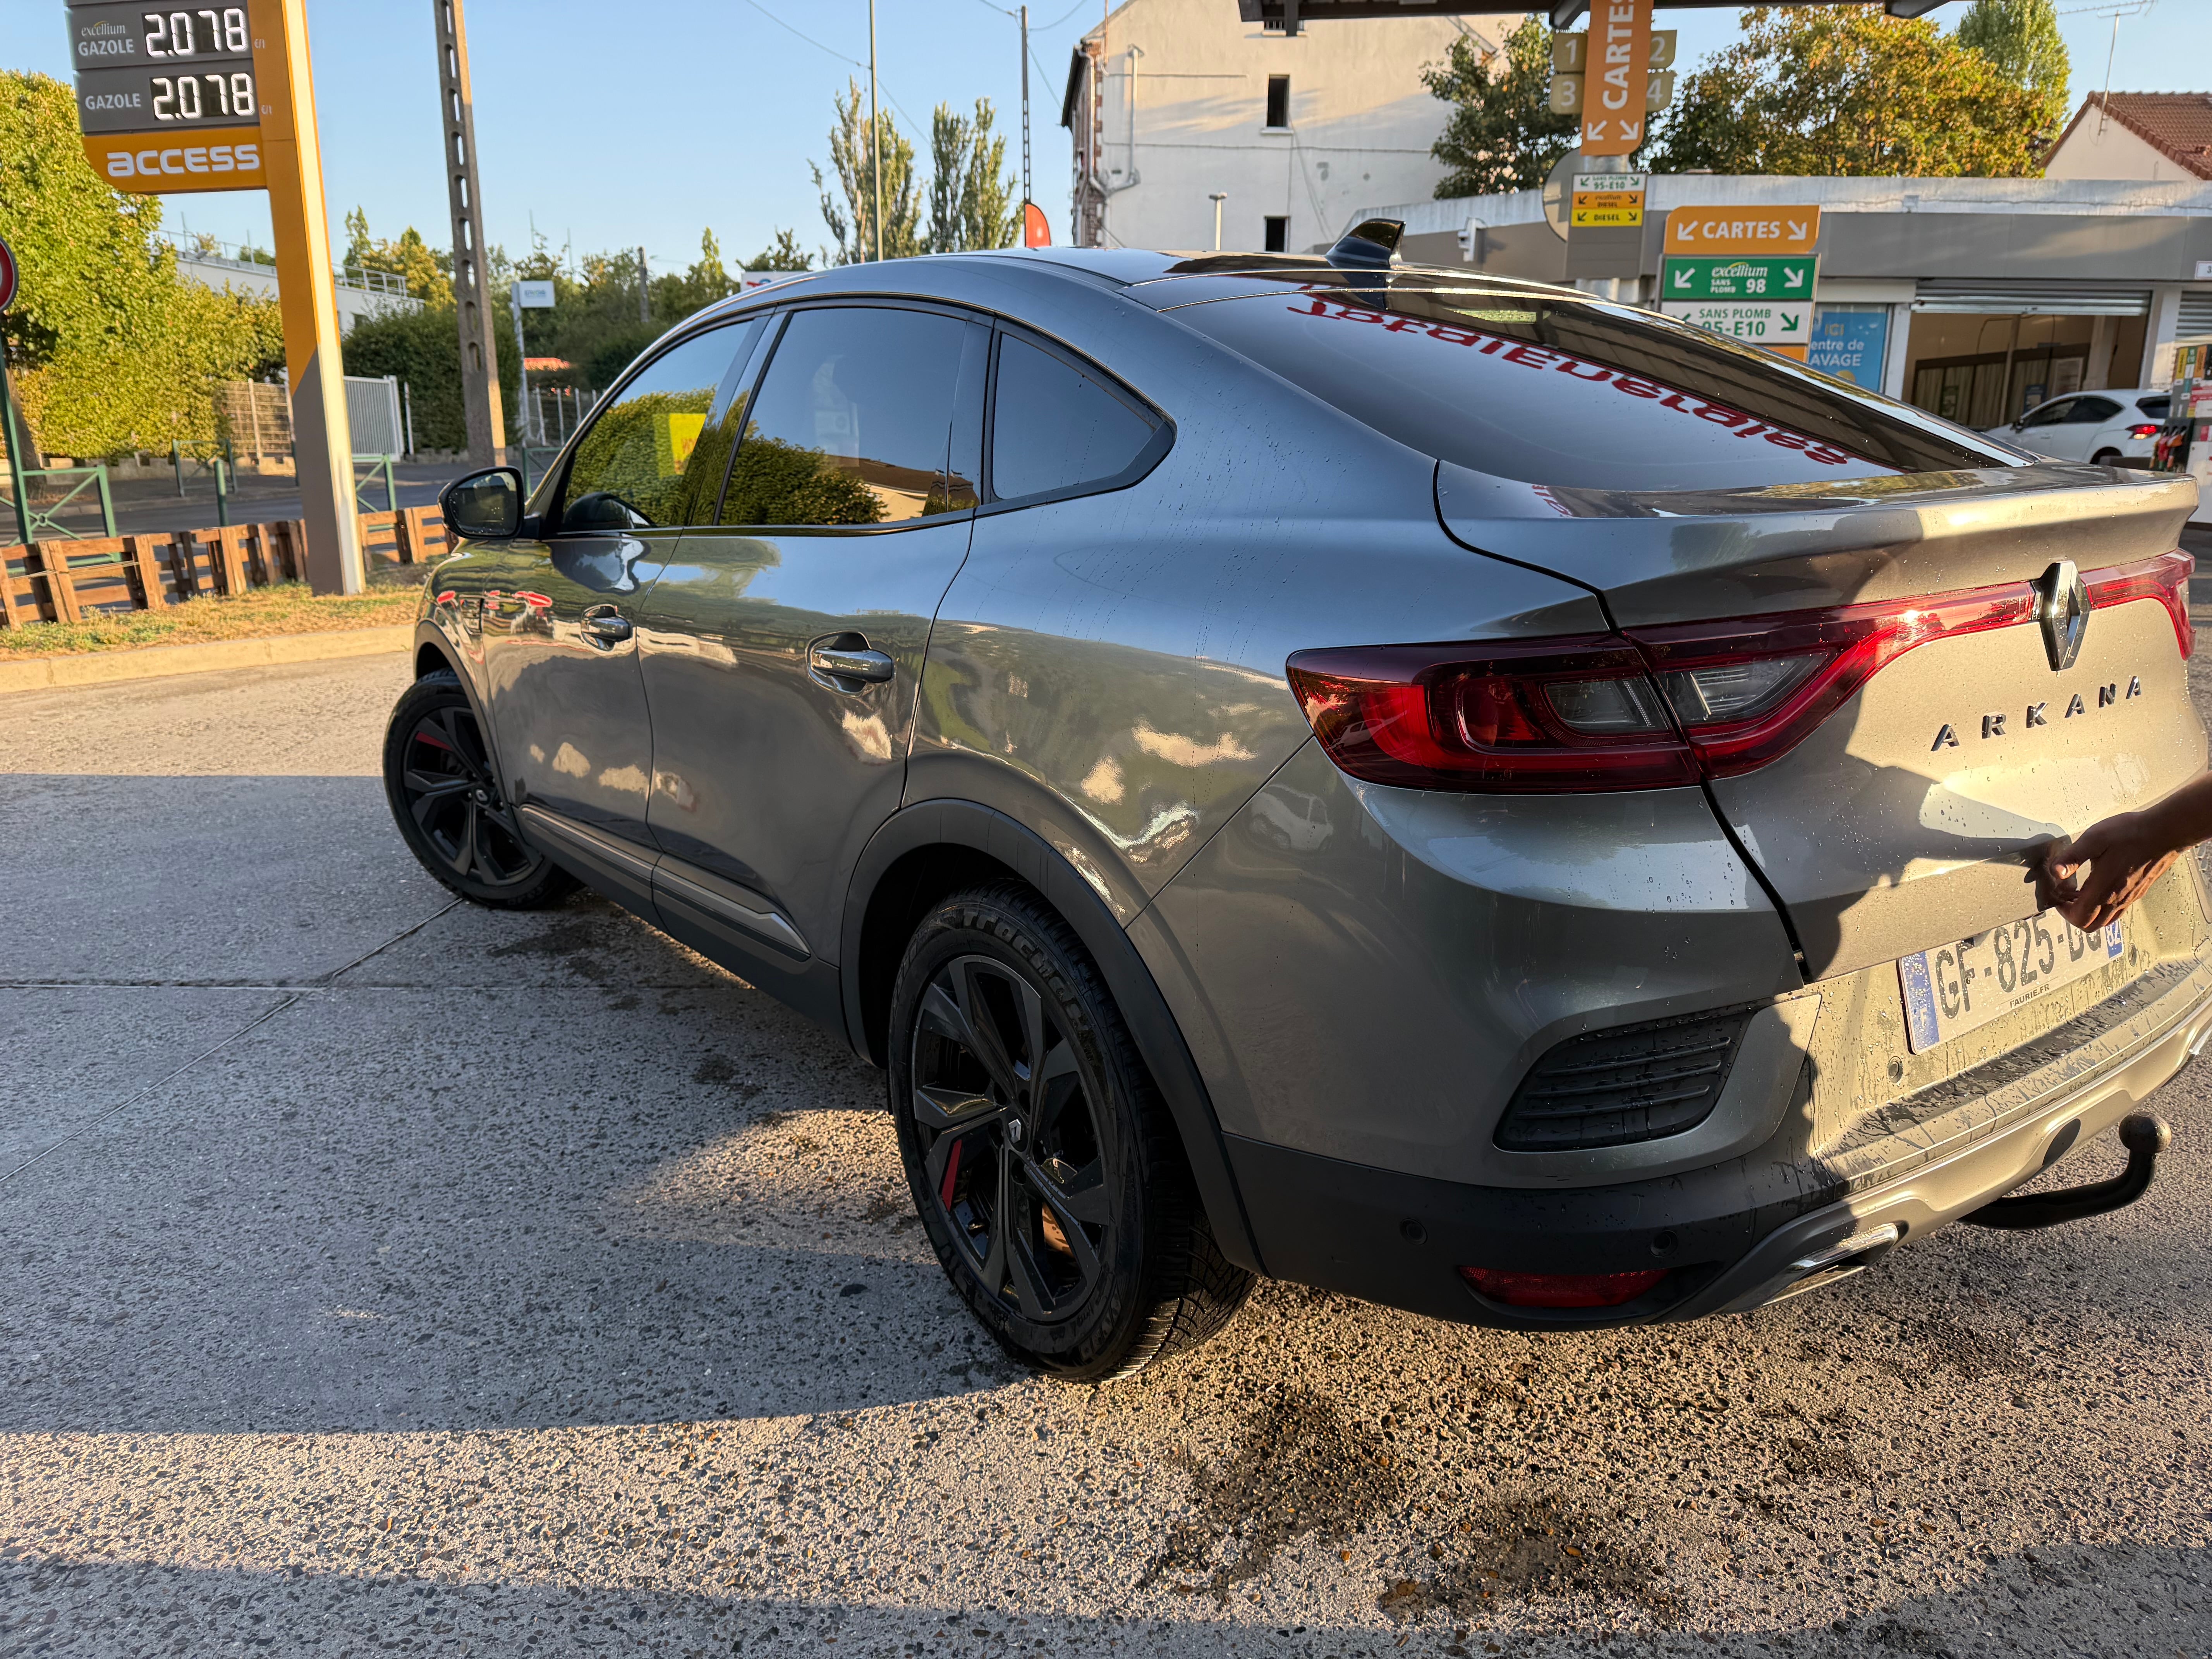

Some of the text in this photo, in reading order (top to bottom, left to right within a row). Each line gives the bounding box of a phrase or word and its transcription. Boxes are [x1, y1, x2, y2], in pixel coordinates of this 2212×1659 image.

[81, 21, 125, 38] excellium
[144, 8, 248, 58] 2.078
[78, 38, 135, 57] GAZOLE
[1565, 39, 1577, 64] 1
[1602, 0, 1634, 110] CARTE
[1649, 36, 1665, 62] 2
[153, 73, 255, 121] 2.078
[1561, 82, 1576, 106] 3
[1647, 78, 1663, 104] 4
[85, 93, 141, 110] GAZOLE
[1702, 221, 1781, 239] CARTES
[1711, 262, 1768, 277] excellium
[1710, 286, 1736, 294] PLOMB
[1746, 278, 1766, 294] 98
[1698, 308, 1771, 319] SANS PLOMB
[1824, 324, 1844, 337] ICI
[1811, 338, 1865, 350] entre de
[1809, 354, 1862, 366] AVAGE
[1930, 675, 2142, 752] ARKANA
[2009, 984, 2050, 1008] FAURIE.FR
[1919, 1007, 1928, 1027] F
